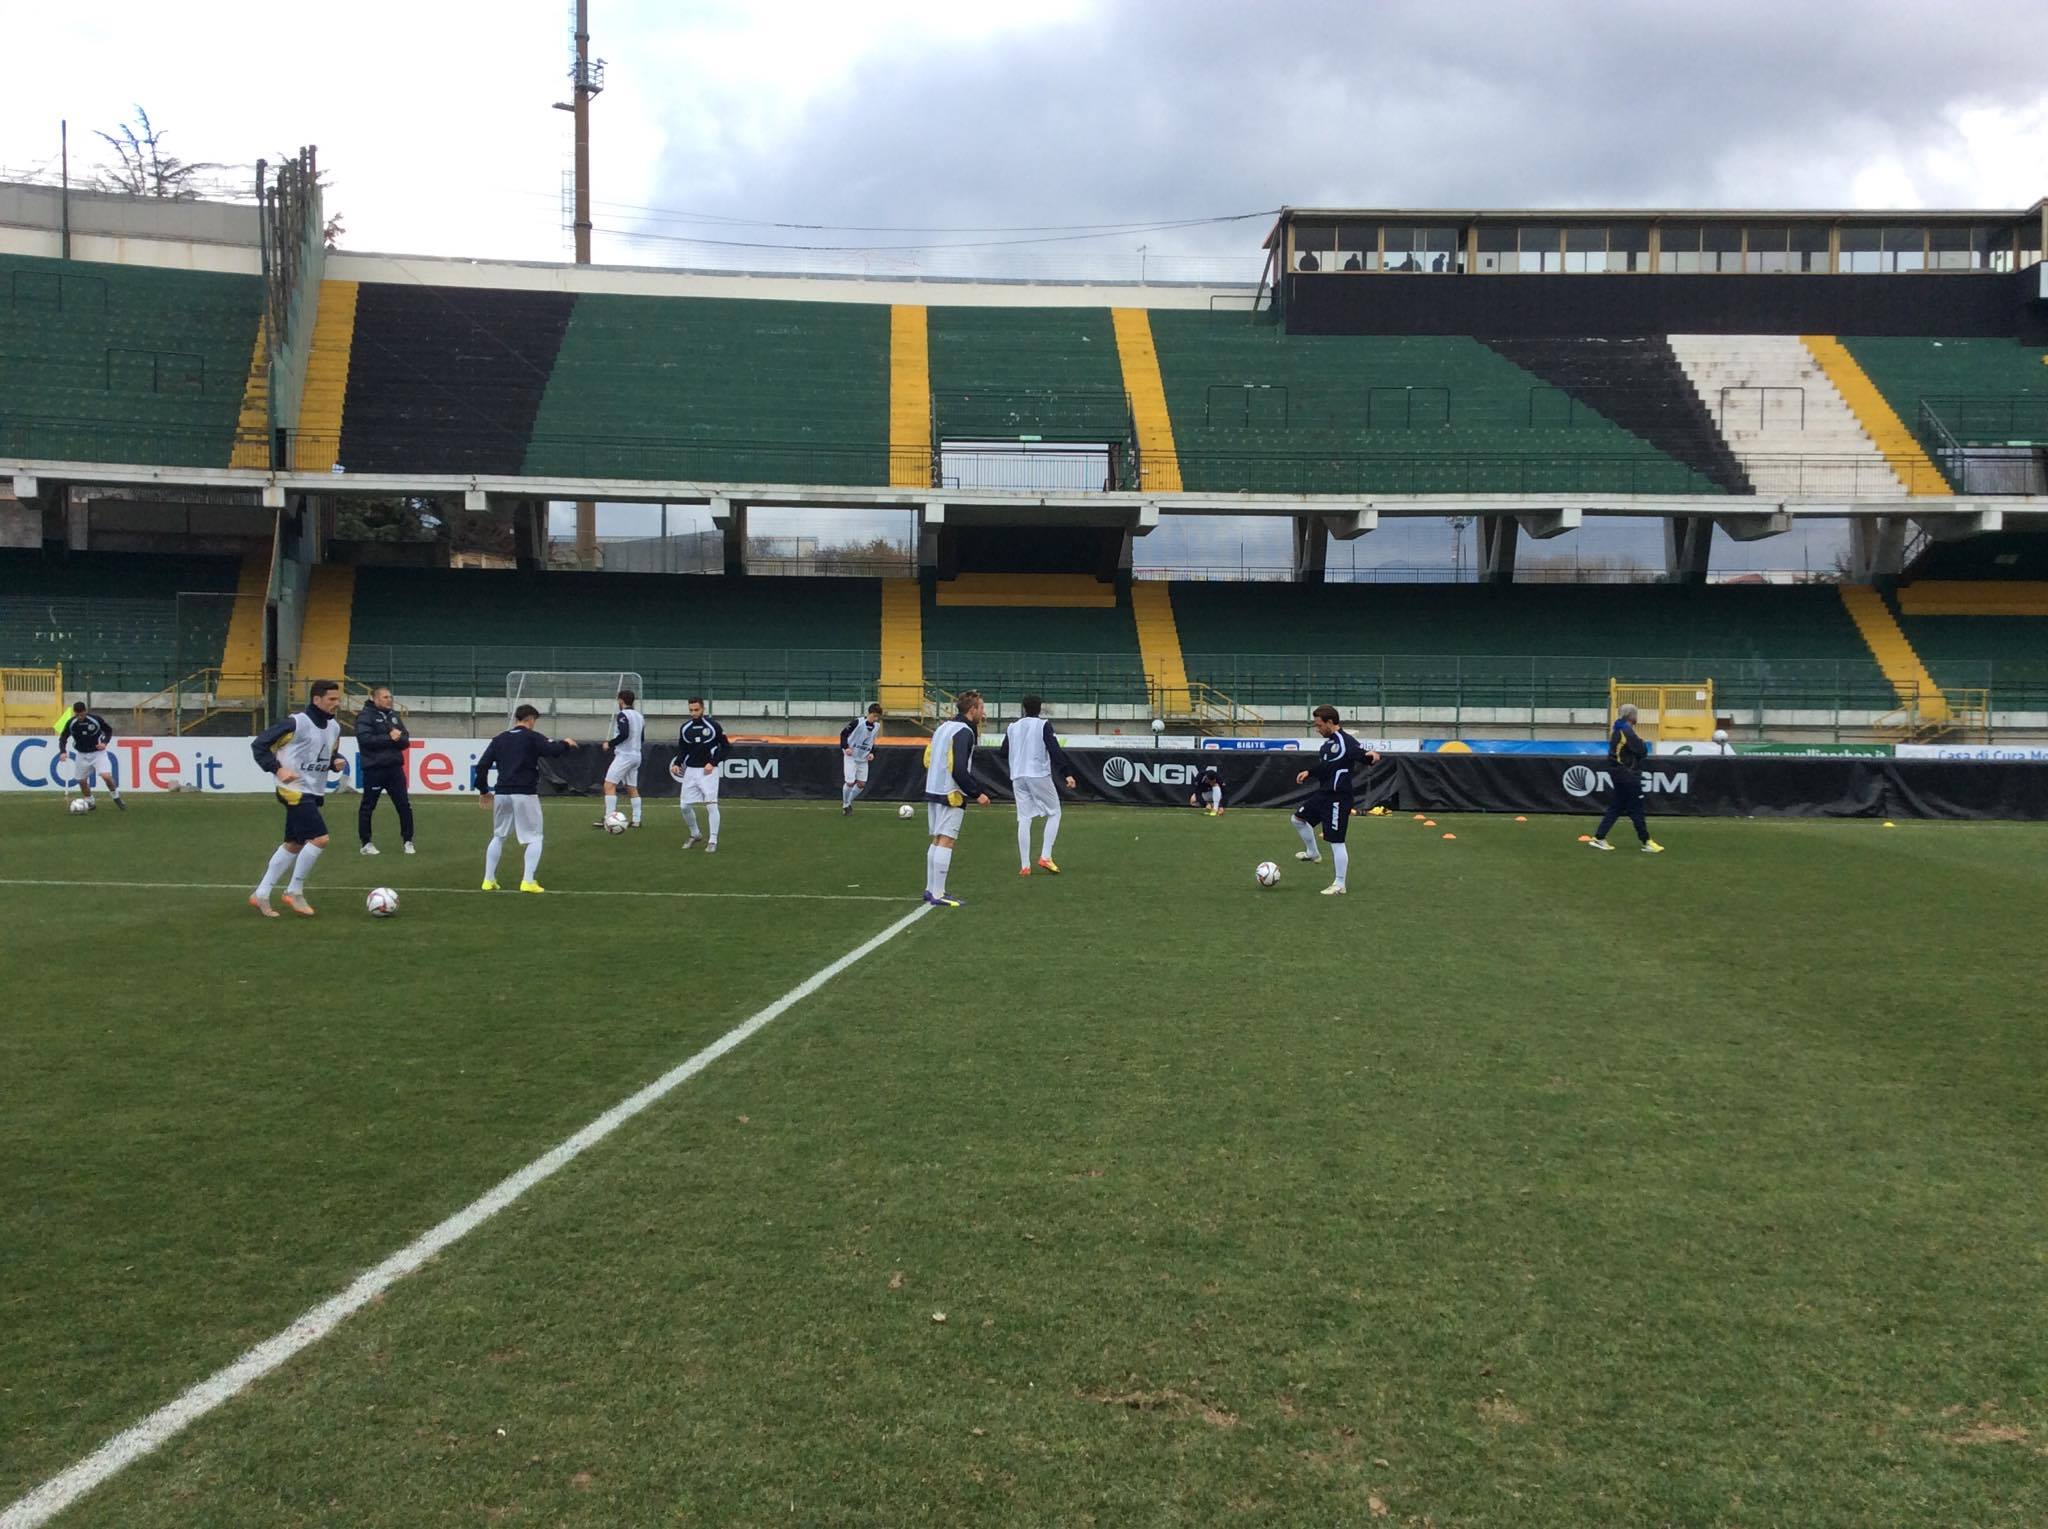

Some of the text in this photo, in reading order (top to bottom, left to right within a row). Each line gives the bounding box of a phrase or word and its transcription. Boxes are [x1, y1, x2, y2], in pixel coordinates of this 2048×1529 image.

[1938, 749, 1970, 760] Casa
[1976, 749, 1988, 760] di
[1994, 750, 2025, 760] Cura
